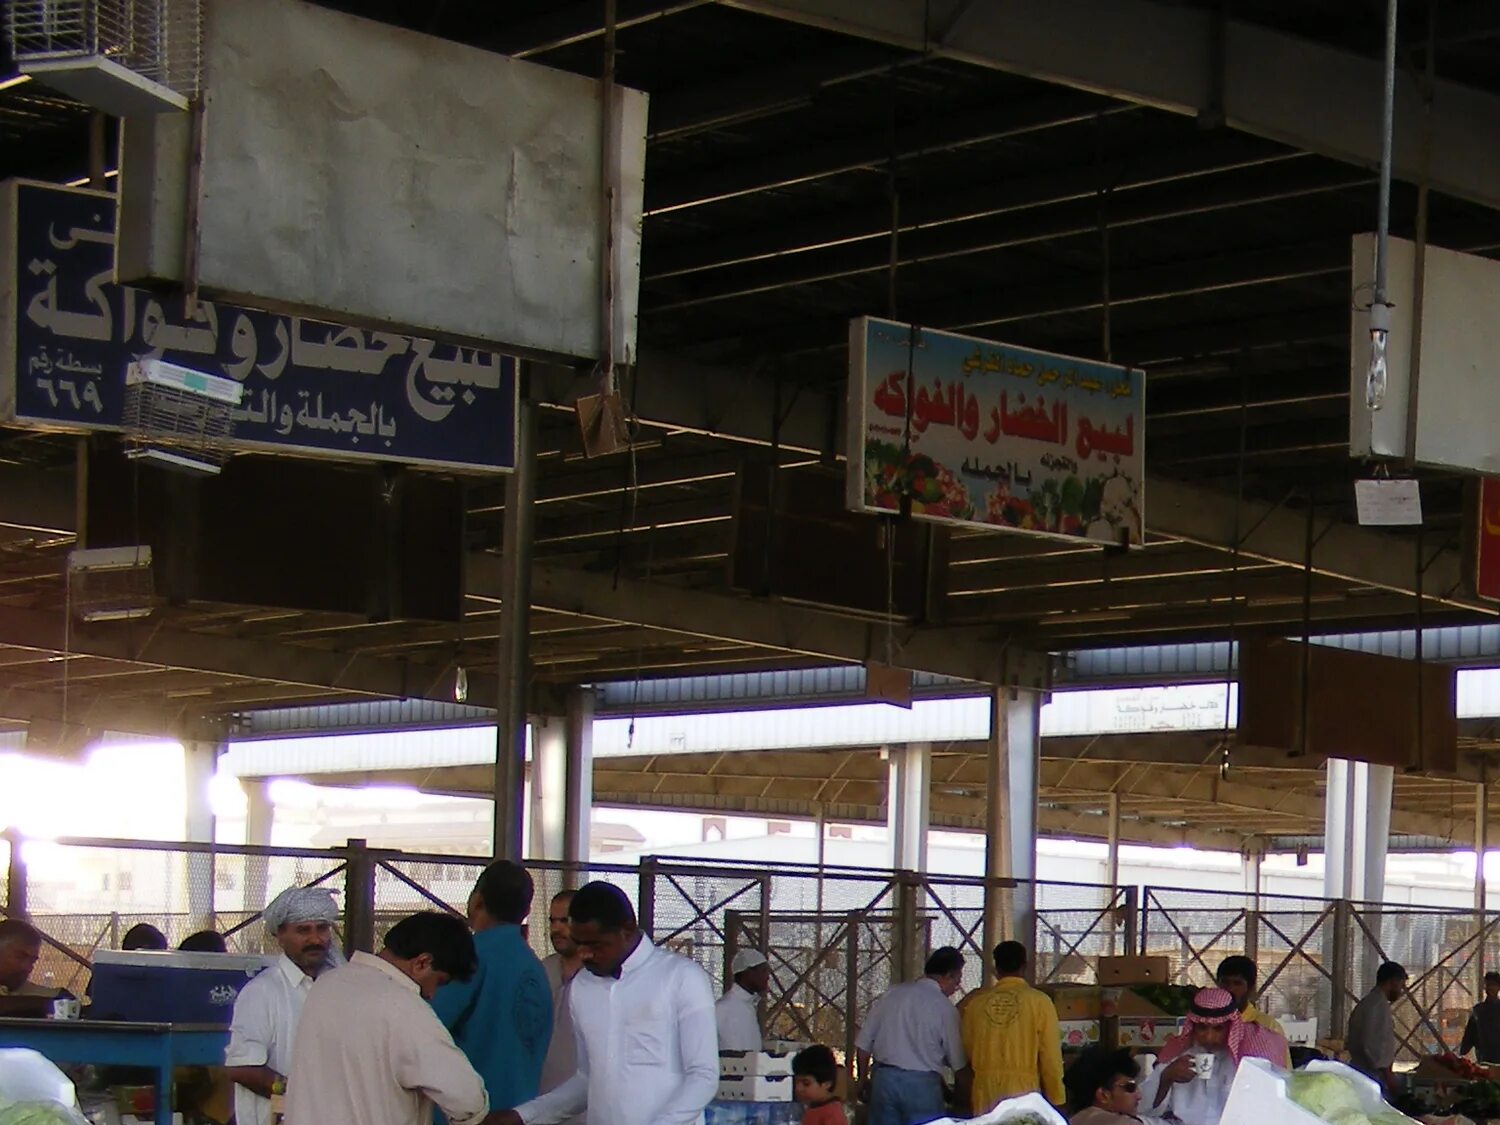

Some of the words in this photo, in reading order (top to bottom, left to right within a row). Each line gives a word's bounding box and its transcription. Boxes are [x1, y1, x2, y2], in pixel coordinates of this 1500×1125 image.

[36, 380, 104, 414] ٦٦٩
[297, 389, 397, 447] بالجملة
[983, 386, 1068, 446] الخضار
[1076, 412, 1134, 461] لبيع
